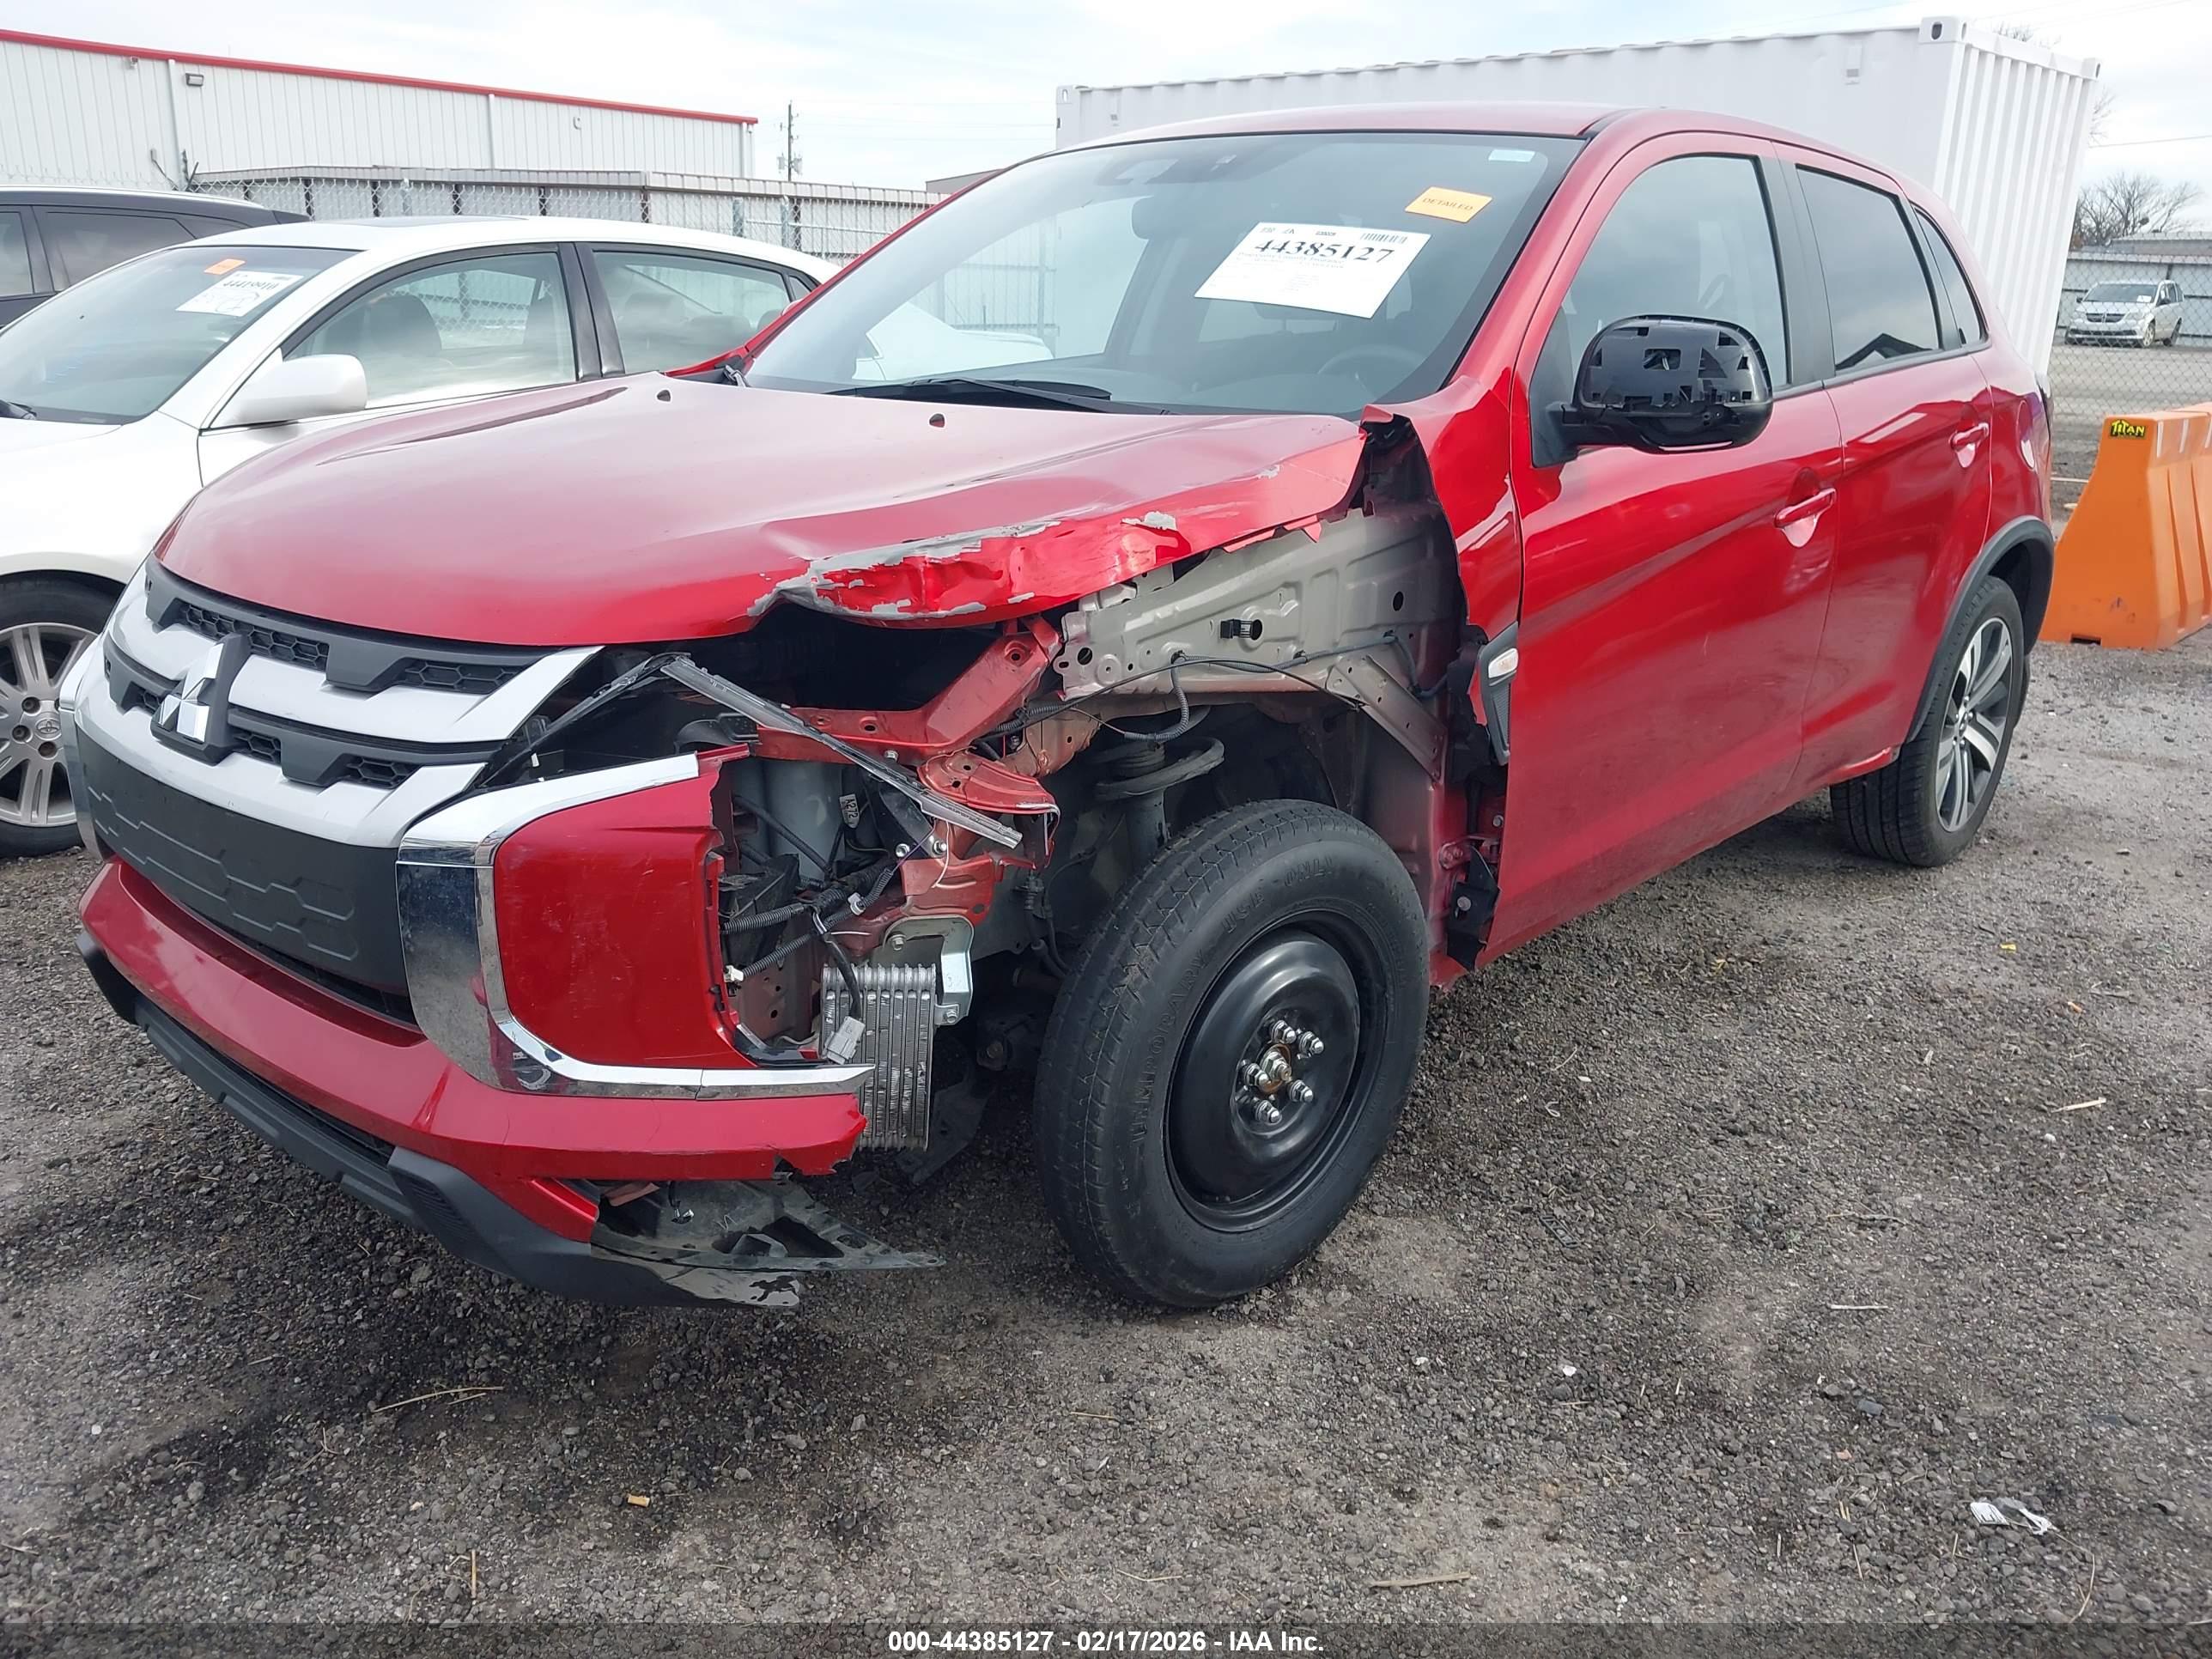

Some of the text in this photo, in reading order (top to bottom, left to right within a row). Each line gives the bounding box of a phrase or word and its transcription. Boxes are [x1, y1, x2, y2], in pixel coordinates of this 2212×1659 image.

[1422, 197, 1474, 211] DETAILED
[1255, 239, 1395, 263] 44385127
[1221, 891, 1265, 933] USE
